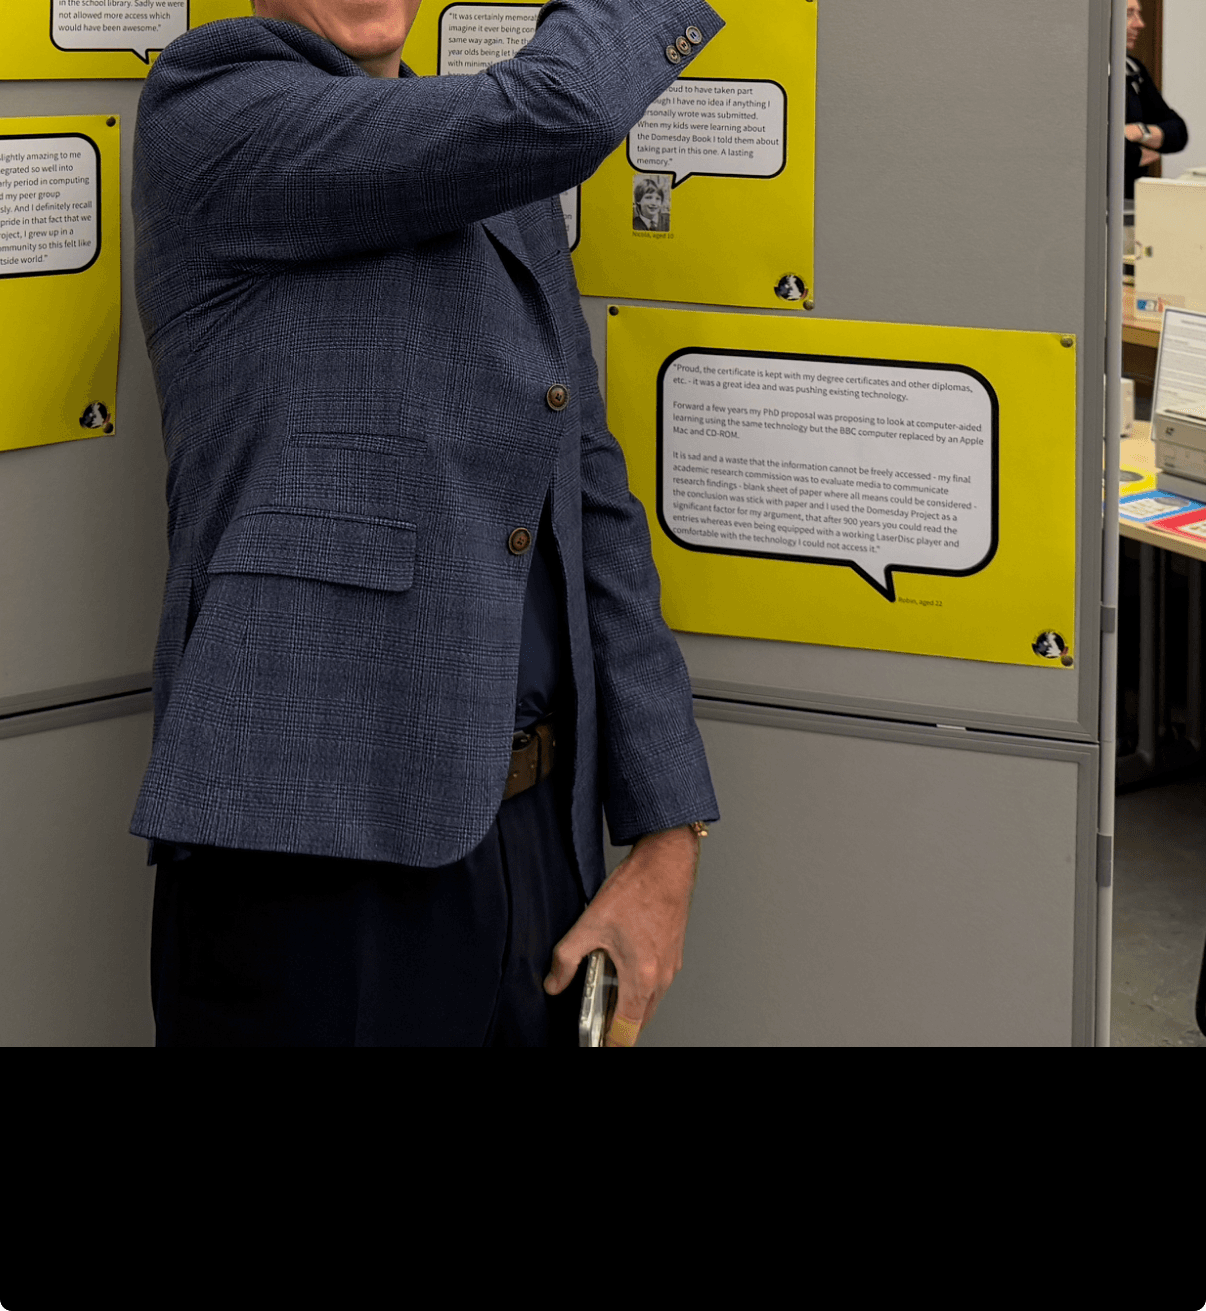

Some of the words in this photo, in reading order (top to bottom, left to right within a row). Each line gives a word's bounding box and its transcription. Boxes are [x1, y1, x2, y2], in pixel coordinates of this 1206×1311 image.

[134, 0, 154, 9] Sadly
[73, 11, 102, 19] allowed
[149, 12, 170, 20] which
[14, 178, 39, 188] period
[49, 176, 90, 186] computing
[14, 204, 30, 212] And
[35, 202, 70, 212] definitely
[72, 201, 92, 209] recall
[0, 218, 20, 227] pride
[673, 488, 685, 497] the
[687, 491, 728, 501] conclusion
[784, 500, 807, 509] paper
[809, 502, 825, 510] and
[851, 505, 865, 513] the
[866, 506, 909, 519] Domesday
[910, 510, 940, 521] Project
[673, 515, 699, 523] entries
[700, 517, 732, 526] whereas
[754, 521, 776, 533] being
[777, 525, 815, 535] equipped
[816, 528, 834, 536] with
[842, 530, 875, 542] working
[876, 533, 914, 544] LaserDisc
[916, 537, 942, 547] player
